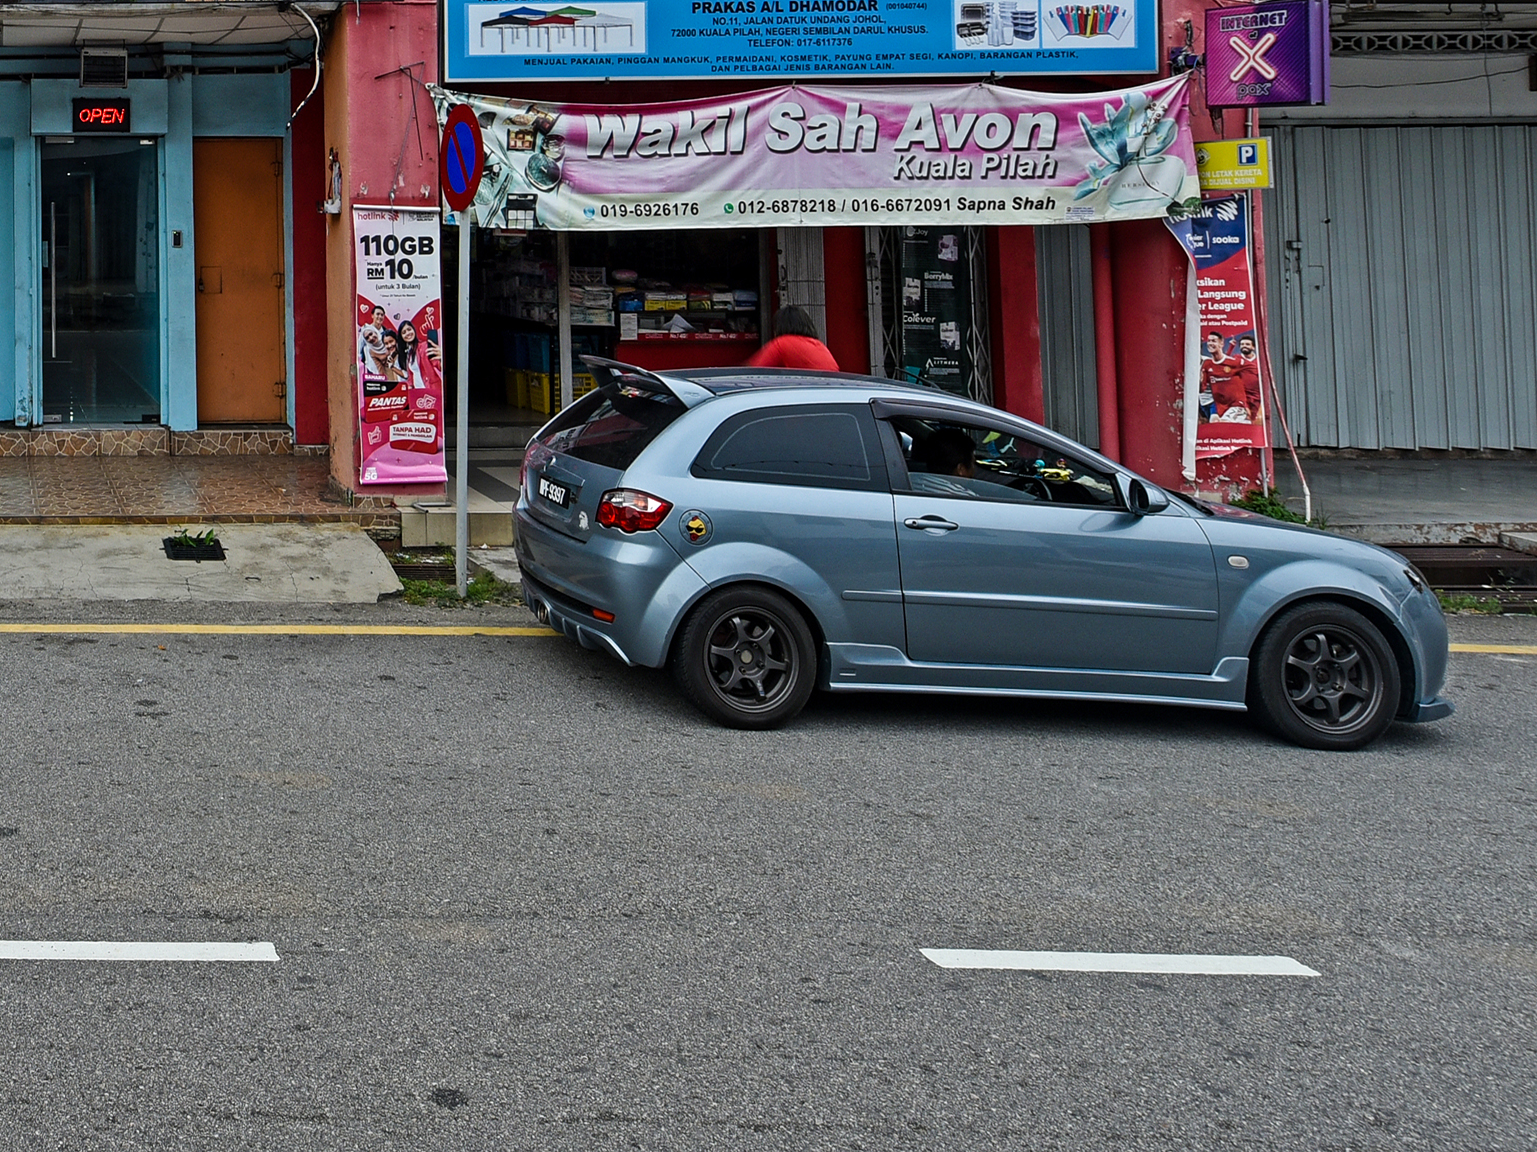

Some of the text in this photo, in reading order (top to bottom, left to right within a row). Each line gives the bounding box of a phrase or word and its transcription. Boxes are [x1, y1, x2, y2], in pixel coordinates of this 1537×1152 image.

[692, 0, 928, 14] PRAKAS A/L DHAMODAR (001040744)
[712, 15, 886, 26] NO.11, JALAN DATUK UNDANG JOHOL,
[1220, 10, 1287, 32] INTERNET
[671, 25, 929, 37] 72000 KUALA PILAH, NEGERI SEMBILAN DARUL KHUSUS.
[748, 38, 853, 48] TELEFON: 017-6117376
[524, 58, 567, 66] MENJUAL
[571, 58, 614, 66] PAKAIAN,
[618, 57, 660, 65] PINGGAN
[663, 56, 712, 64] MANGKUK,
[716, 55, 777, 63] PERMAIDANI,
[781, 54, 831, 62] KOSMETIK,
[876, 53, 905, 61] EMPAT
[909, 53, 934, 61] SEGI,
[938, 52, 976, 60] KANOPI,
[1036, 51, 1079, 59] PLASTIK,
[1229, 32, 1277, 82] X
[734, 64, 781, 72] PELBAGAI
[814, 63, 867, 71] BARANGAN
[79, 108, 125, 124] OPEN
[583, 102, 1058, 159] Wakil Sah Avon
[1241, 145, 1254, 164] P
[893, 153, 1058, 181] Kuala Pilah
[1235, 168, 1262, 176] KERETA
[601, 202, 699, 218] 019-6926176
[738, 199, 836, 215] 012-6878218
[851, 198, 951, 212] 016-6672091
[956, 197, 1006, 213] Sapna
[1012, 196, 1056, 211] Shah
[357, 211, 386, 221] hotlink
[360, 234, 435, 256] 110GB
[367, 268, 384, 277] RM
[385, 258, 414, 280] 10
[1197, 290, 1247, 300] Langsung
[1208, 301, 1245, 312] League
[369, 396, 407, 408] PANTAS
[364, 472, 378, 481] 5G
[548, 483, 566, 505] 9397
